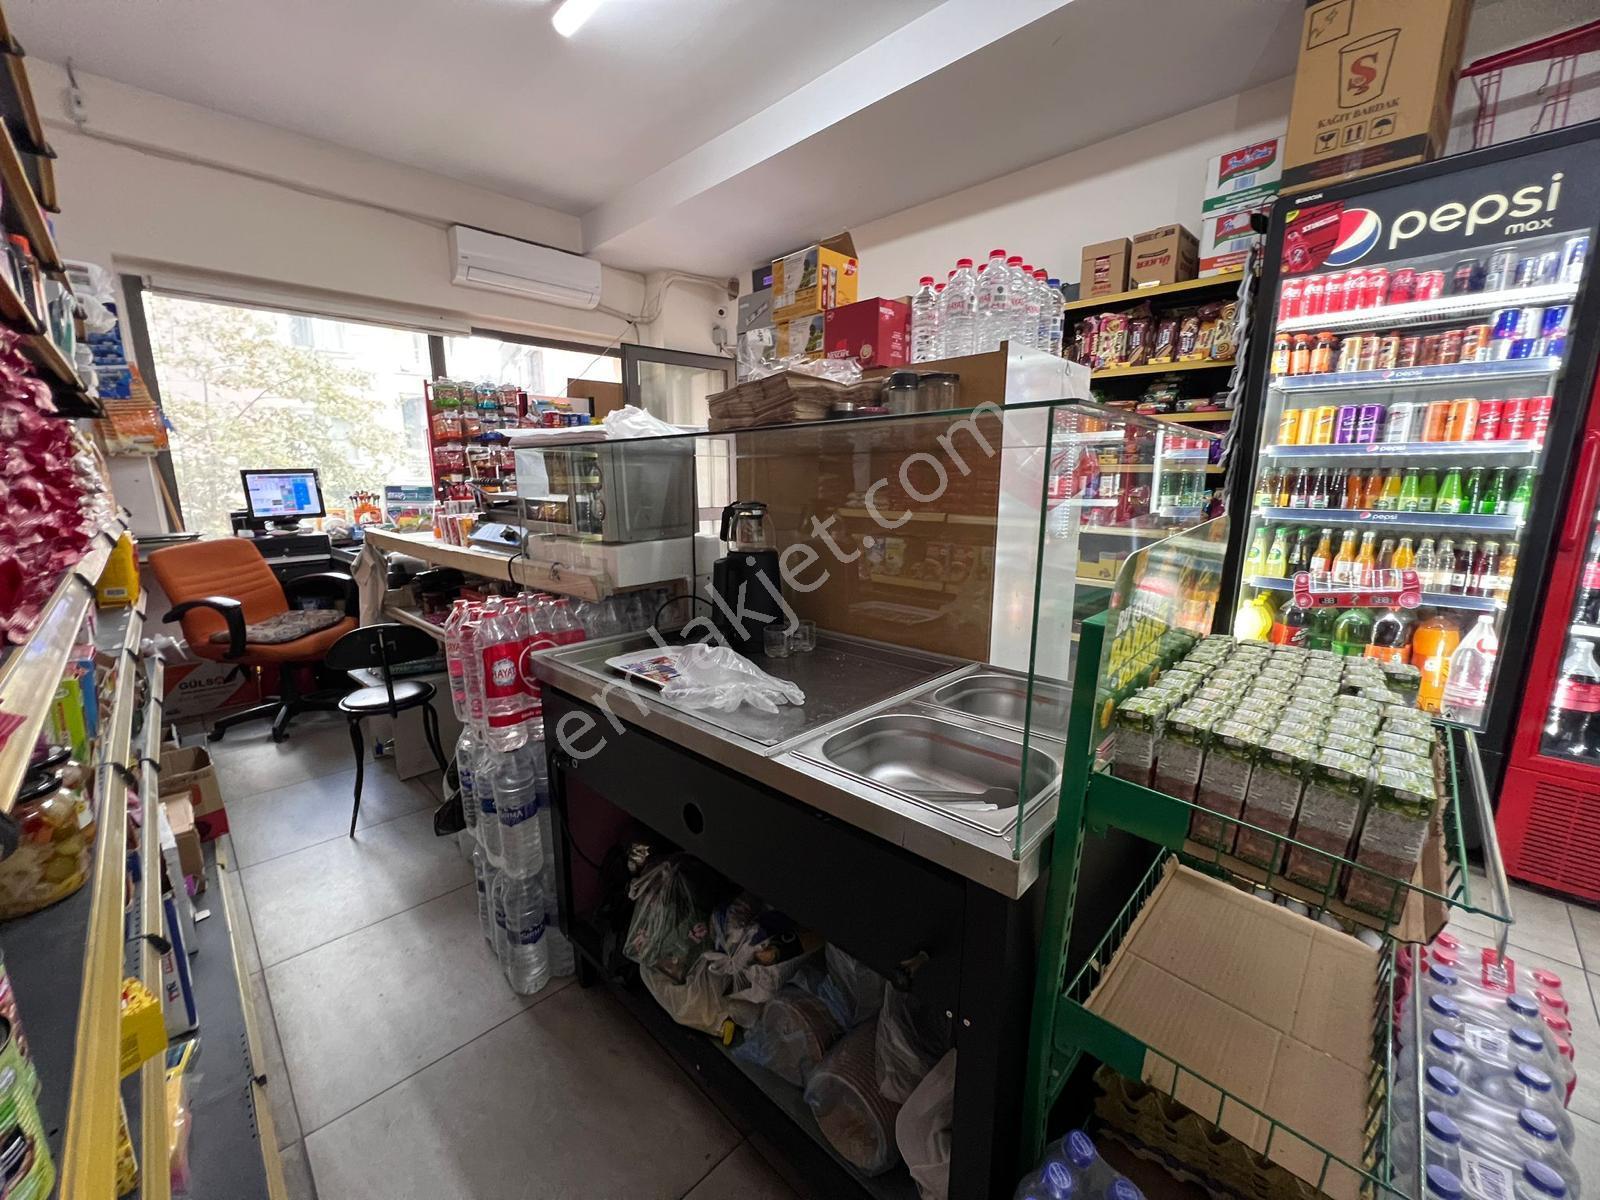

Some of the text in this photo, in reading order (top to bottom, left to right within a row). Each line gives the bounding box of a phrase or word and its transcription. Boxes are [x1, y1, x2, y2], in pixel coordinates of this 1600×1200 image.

[1317, 97, 1400, 129] KAĞIT BARDAK
[1388, 172, 1564, 250] pepsi
[1504, 217, 1555, 236] max
[1396, 369, 1423, 378] pepsi
[1379, 445, 1407, 453] pepsi
